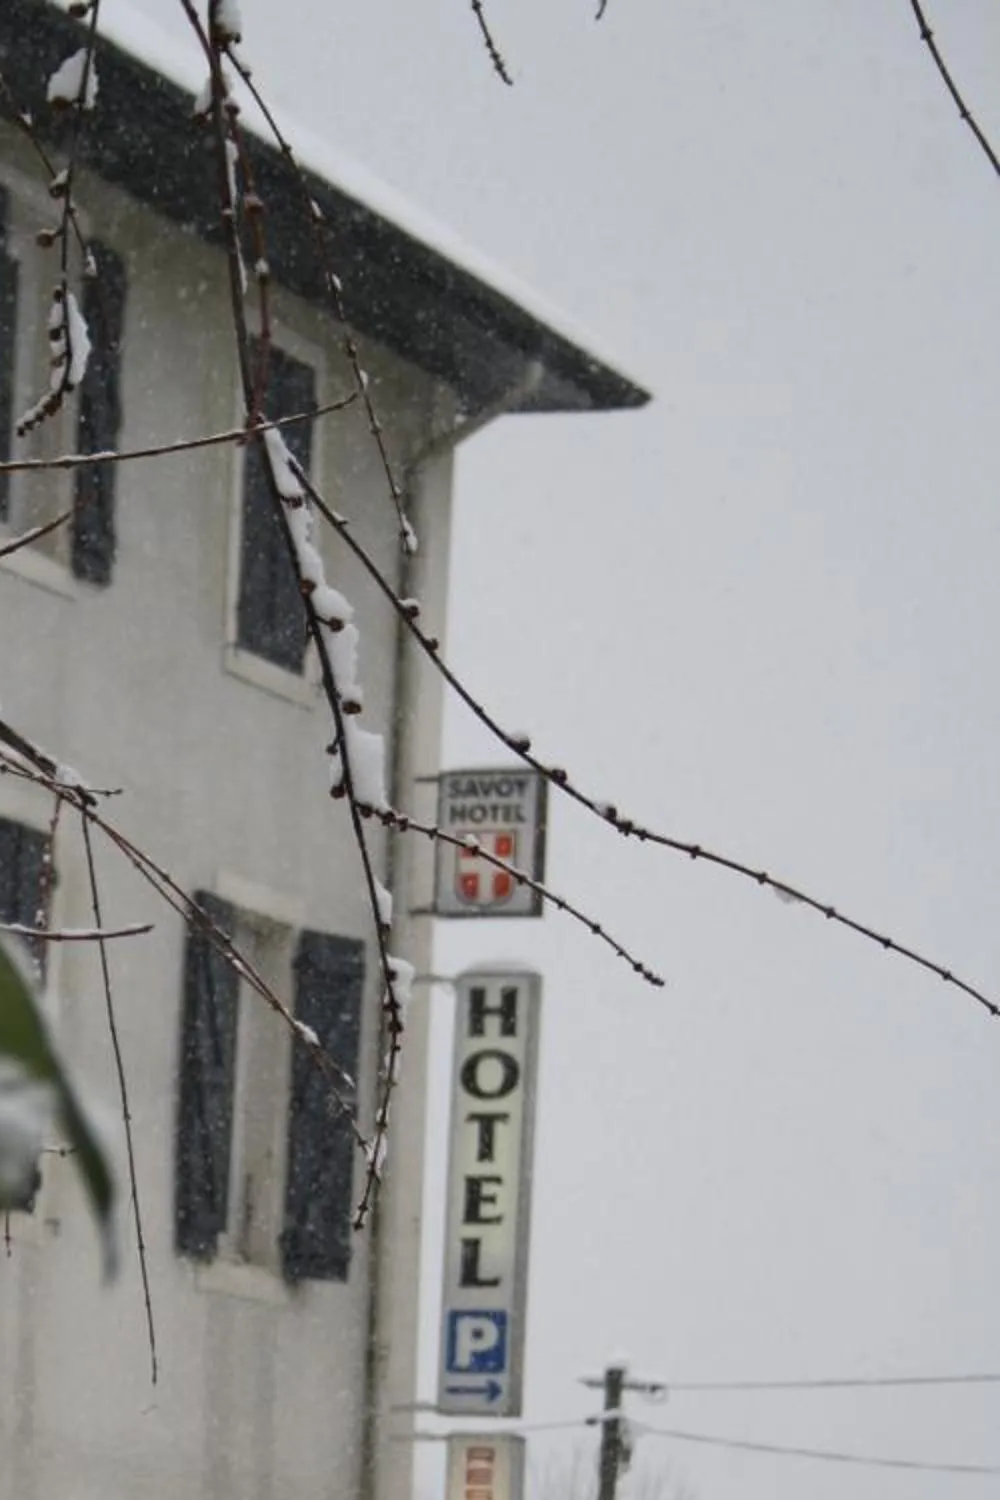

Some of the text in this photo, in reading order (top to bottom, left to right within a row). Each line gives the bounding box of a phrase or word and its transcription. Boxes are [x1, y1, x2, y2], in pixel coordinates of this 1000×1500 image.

[448, 777, 528, 798] SAVOY
[450, 803, 526, 823] HOTEL
[459, 985, 520, 1289] HOTEL
